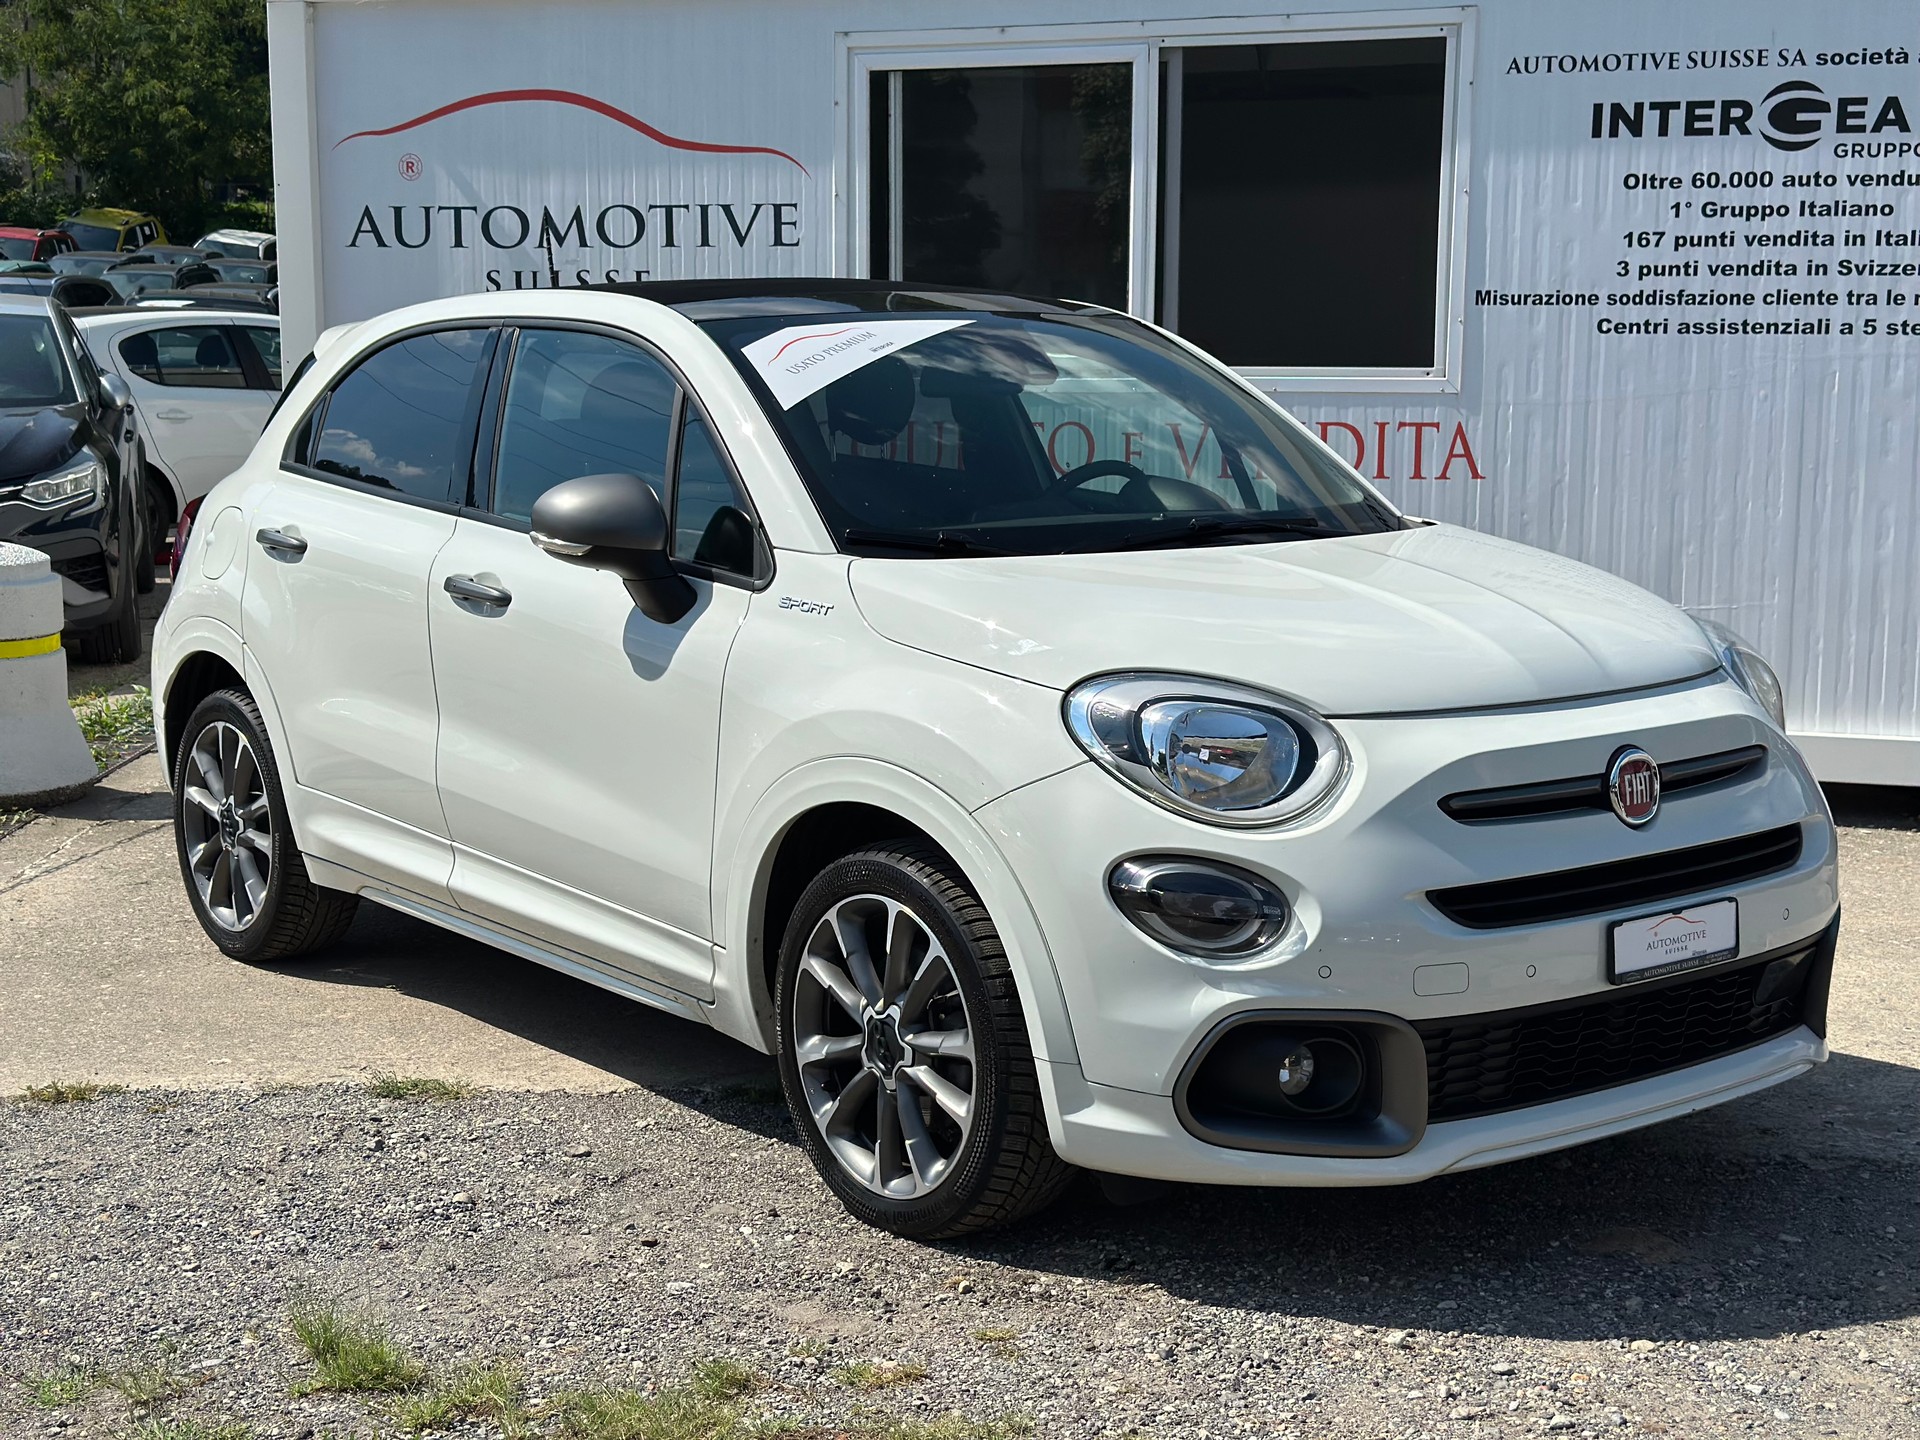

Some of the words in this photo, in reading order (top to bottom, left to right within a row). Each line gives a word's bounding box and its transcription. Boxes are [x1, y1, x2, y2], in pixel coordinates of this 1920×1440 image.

[1506, 52, 1679, 74] AUTOMOTIVE
[1687, 49, 1768, 69] SUISSE
[1778, 49, 1806, 67] SA
[1816, 47, 1908, 65] società
[1591, 81, 1911, 152] INTERGEA
[1624, 174, 1682, 189] Oltre
[1692, 171, 1773, 188] 60.000
[1782, 171, 1837, 187] auto
[1847, 170, 1920, 186] vendu
[1701, 202, 1789, 221] Gruppo
[1800, 200, 1894, 217] Italiano
[345, 202, 800, 249] AUTOMOTIVE
[1624, 232, 1665, 247] 167
[1674, 231, 1735, 251] punti
[1744, 230, 1834, 246] vendita
[1845, 230, 1865, 246] in
[1617, 261, 1629, 277] 3
[1639, 261, 1698, 280] punti
[1708, 260, 1797, 276] vendita
[1807, 260, 1827, 276] in
[1837, 260, 1920, 276] Svizze
[1475, 290, 1599, 305] Misurazione
[1607, 290, 1755, 305] soddisfazione
[1763, 289, 1838, 305] cliente
[1847, 290, 1877, 305] tra
[1887, 289, 1905, 305] le
[1597, 318, 1668, 334] Centri
[1677, 319, 1830, 334] assistenziali
[1840, 323, 1853, 335] a
[1863, 319, 1876, 335] 5
[785, 352, 826, 375] USATO
[822, 331, 877, 357] PREMIUM
[779, 596, 834, 616] SPORT
[1624, 771, 1651, 806] FIAT
[1646, 929, 1707, 951] AUTOMOTIVE
[1665, 945, 1689, 955] SUISSE
